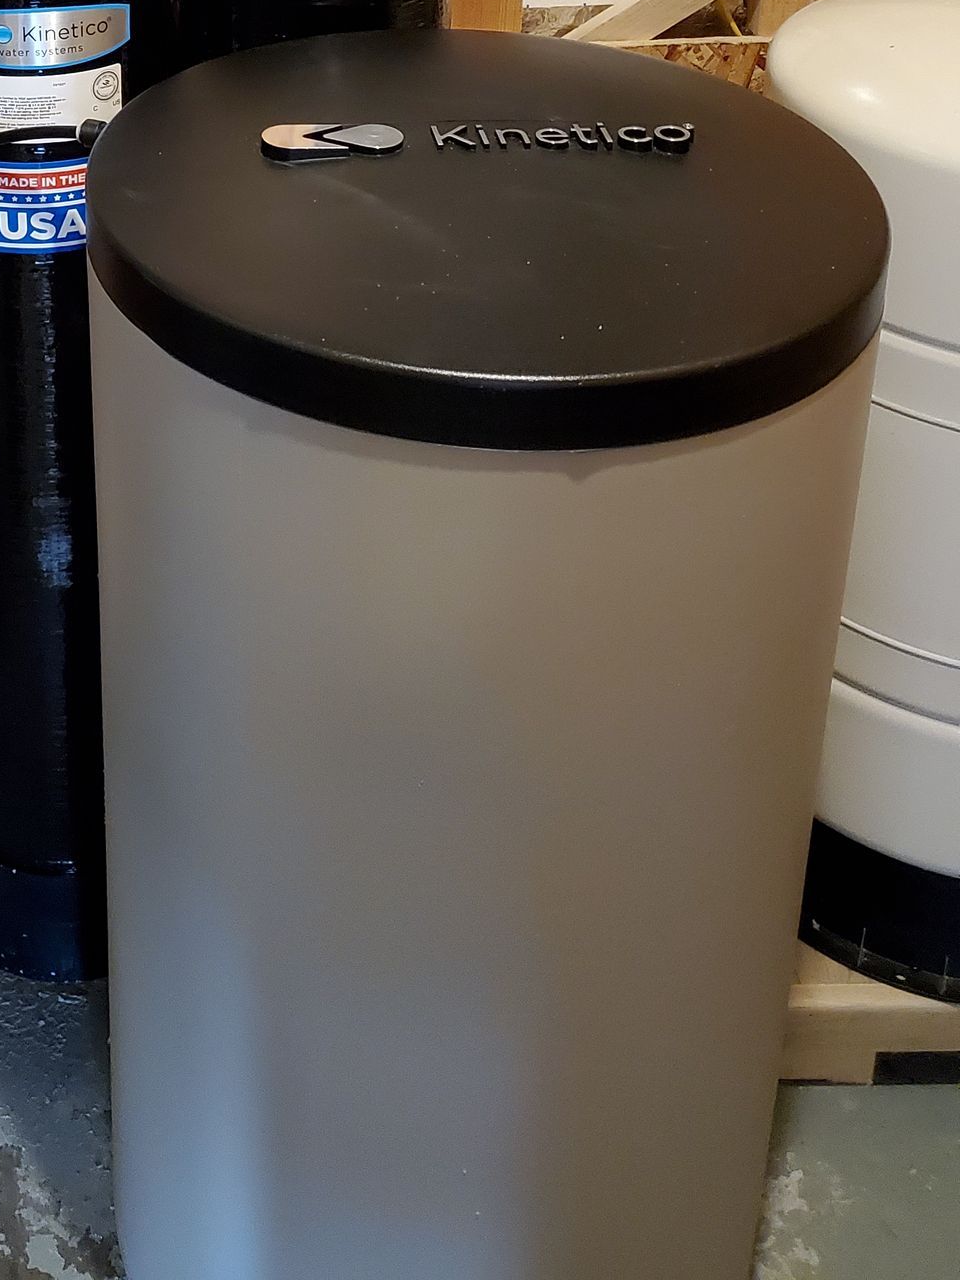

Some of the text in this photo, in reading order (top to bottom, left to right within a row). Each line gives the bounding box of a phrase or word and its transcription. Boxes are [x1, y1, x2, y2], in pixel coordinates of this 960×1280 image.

[22, 19, 110, 43] Kinetico
[34, 44, 84, 58] systems
[429, 121, 692, 154] Kinetico
[41, 175, 57, 188] IN
[59, 172, 87, 186] THE
